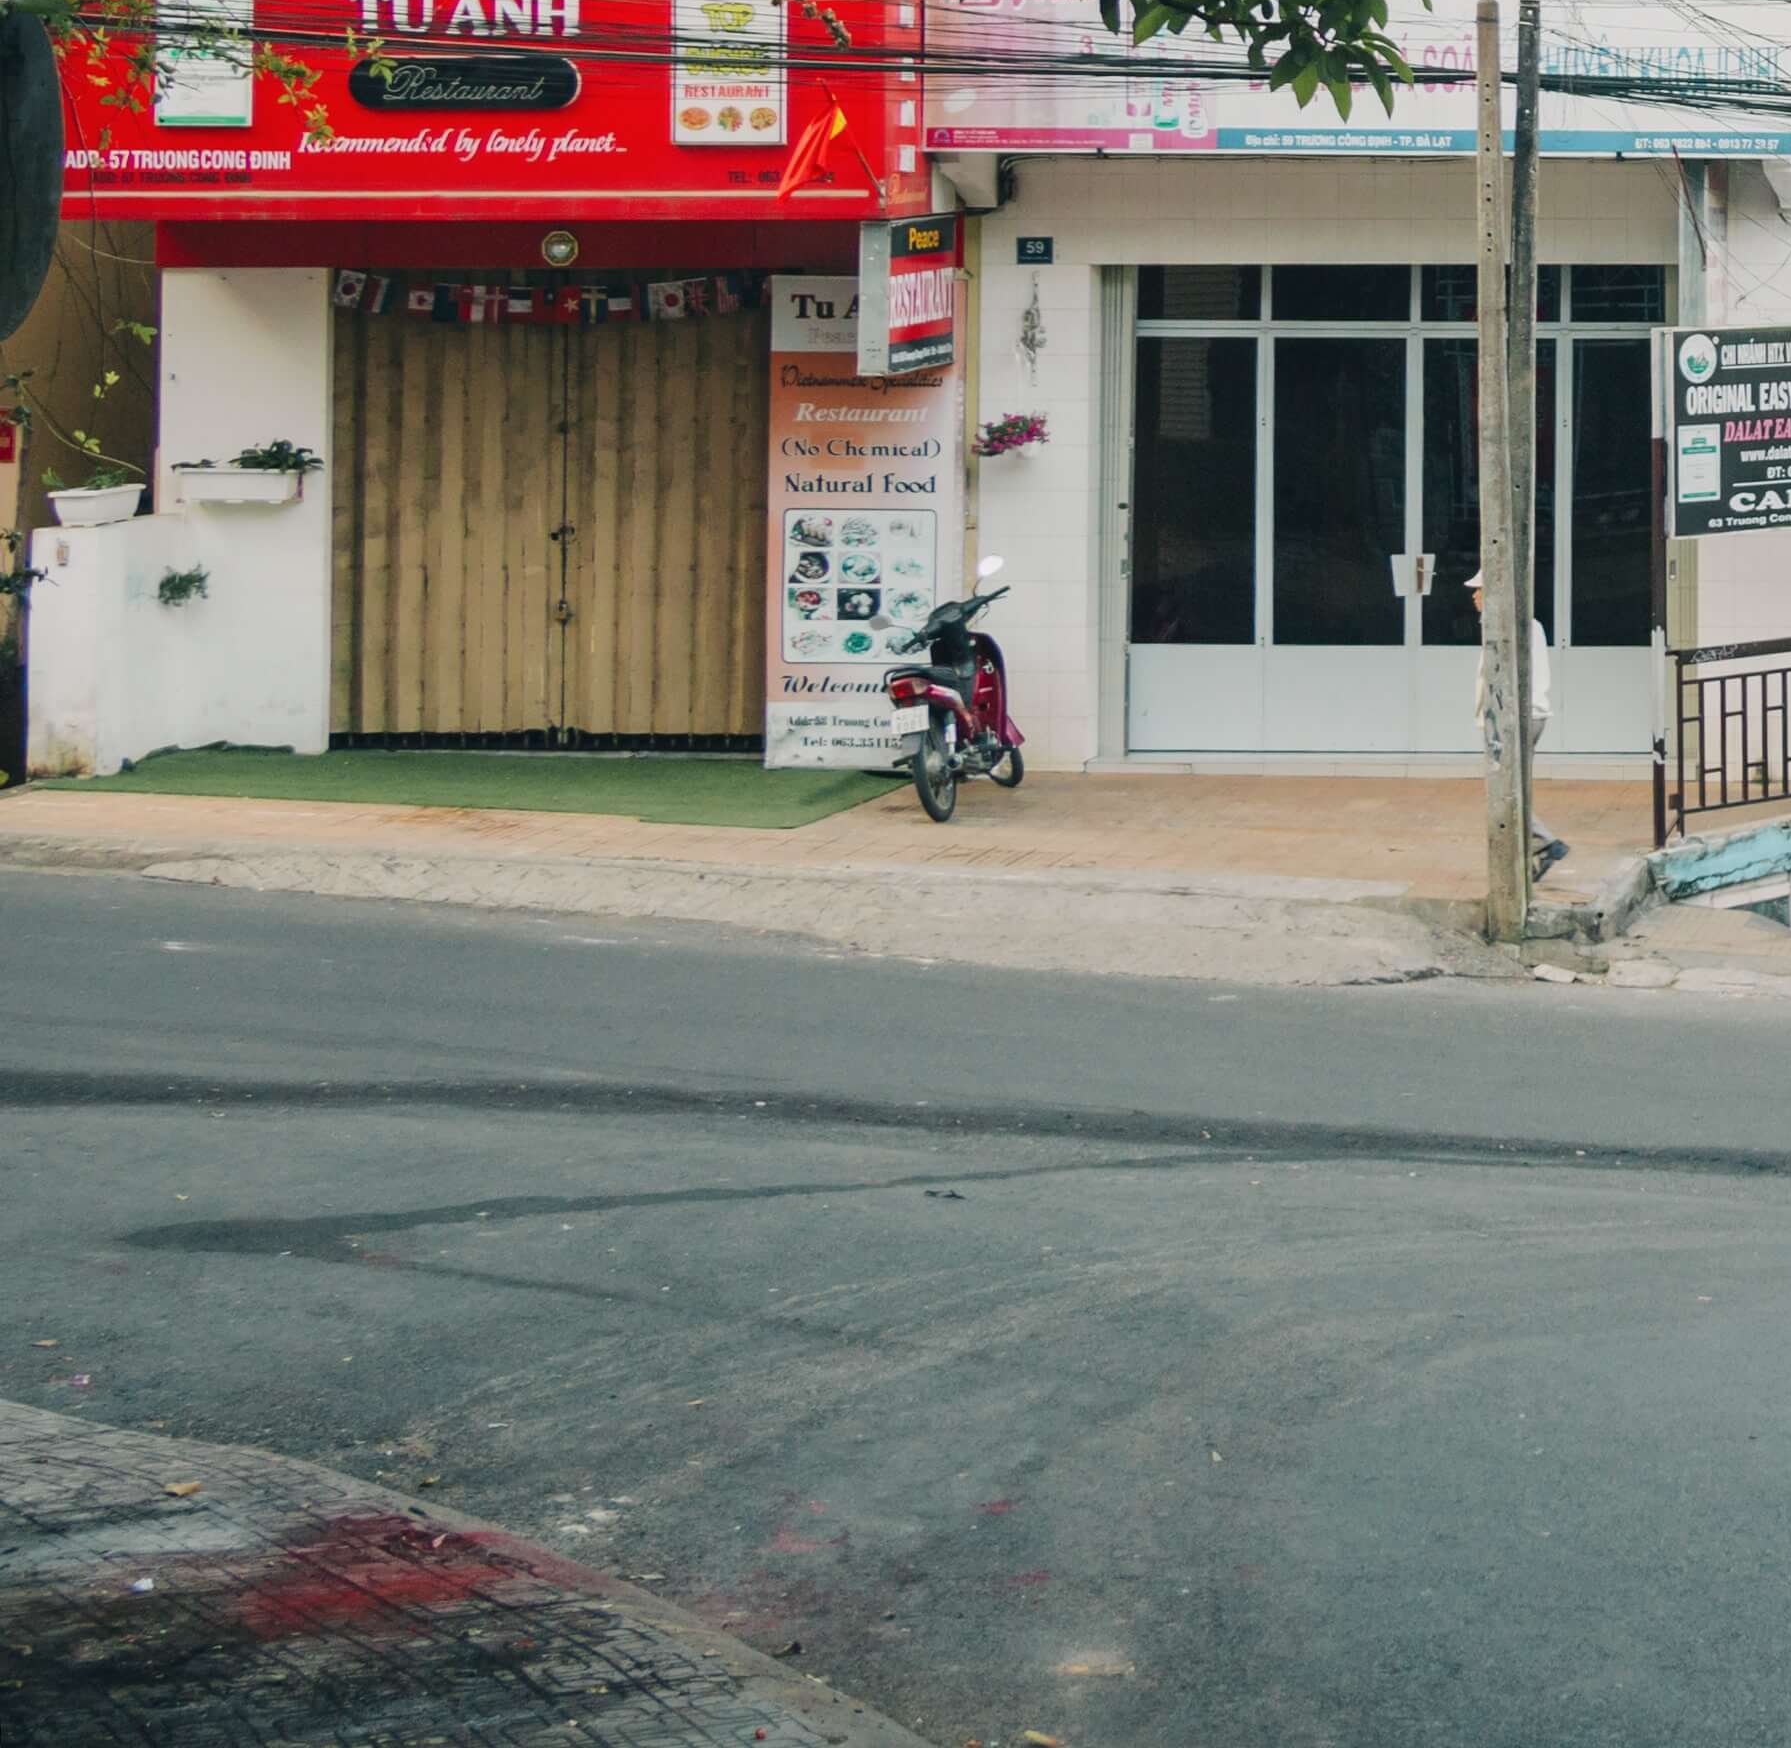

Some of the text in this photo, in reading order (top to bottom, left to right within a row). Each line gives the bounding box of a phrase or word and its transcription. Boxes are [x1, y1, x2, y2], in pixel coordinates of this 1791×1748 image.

[383, 64, 546, 101] Restaurant
[684, 84, 769, 99] RESTAURANT
[454, 127, 482, 161] by
[486, 127, 546, 162] lonely
[110, 150, 132, 169] 57
[133, 150, 199, 169] TRUONG
[201, 150, 246, 169] CONG
[909, 227, 940, 251] Peace
[1026, 241, 1045, 254] 59
[791, 293, 836, 319] Tu
[889, 268, 953, 329] RESTAURANT
[1686, 383, 1755, 415] ORIGINAL
[795, 403, 928, 422] Restaurant
[1723, 418, 1773, 443] DALAT
[781, 437, 941, 459] (No Chemical)
[785, 473, 936, 493] Natural Food
[1708, 517, 1724, 529] 63
[1725, 514, 1767, 528] Truong
[782, 675, 888, 693] Welcom
